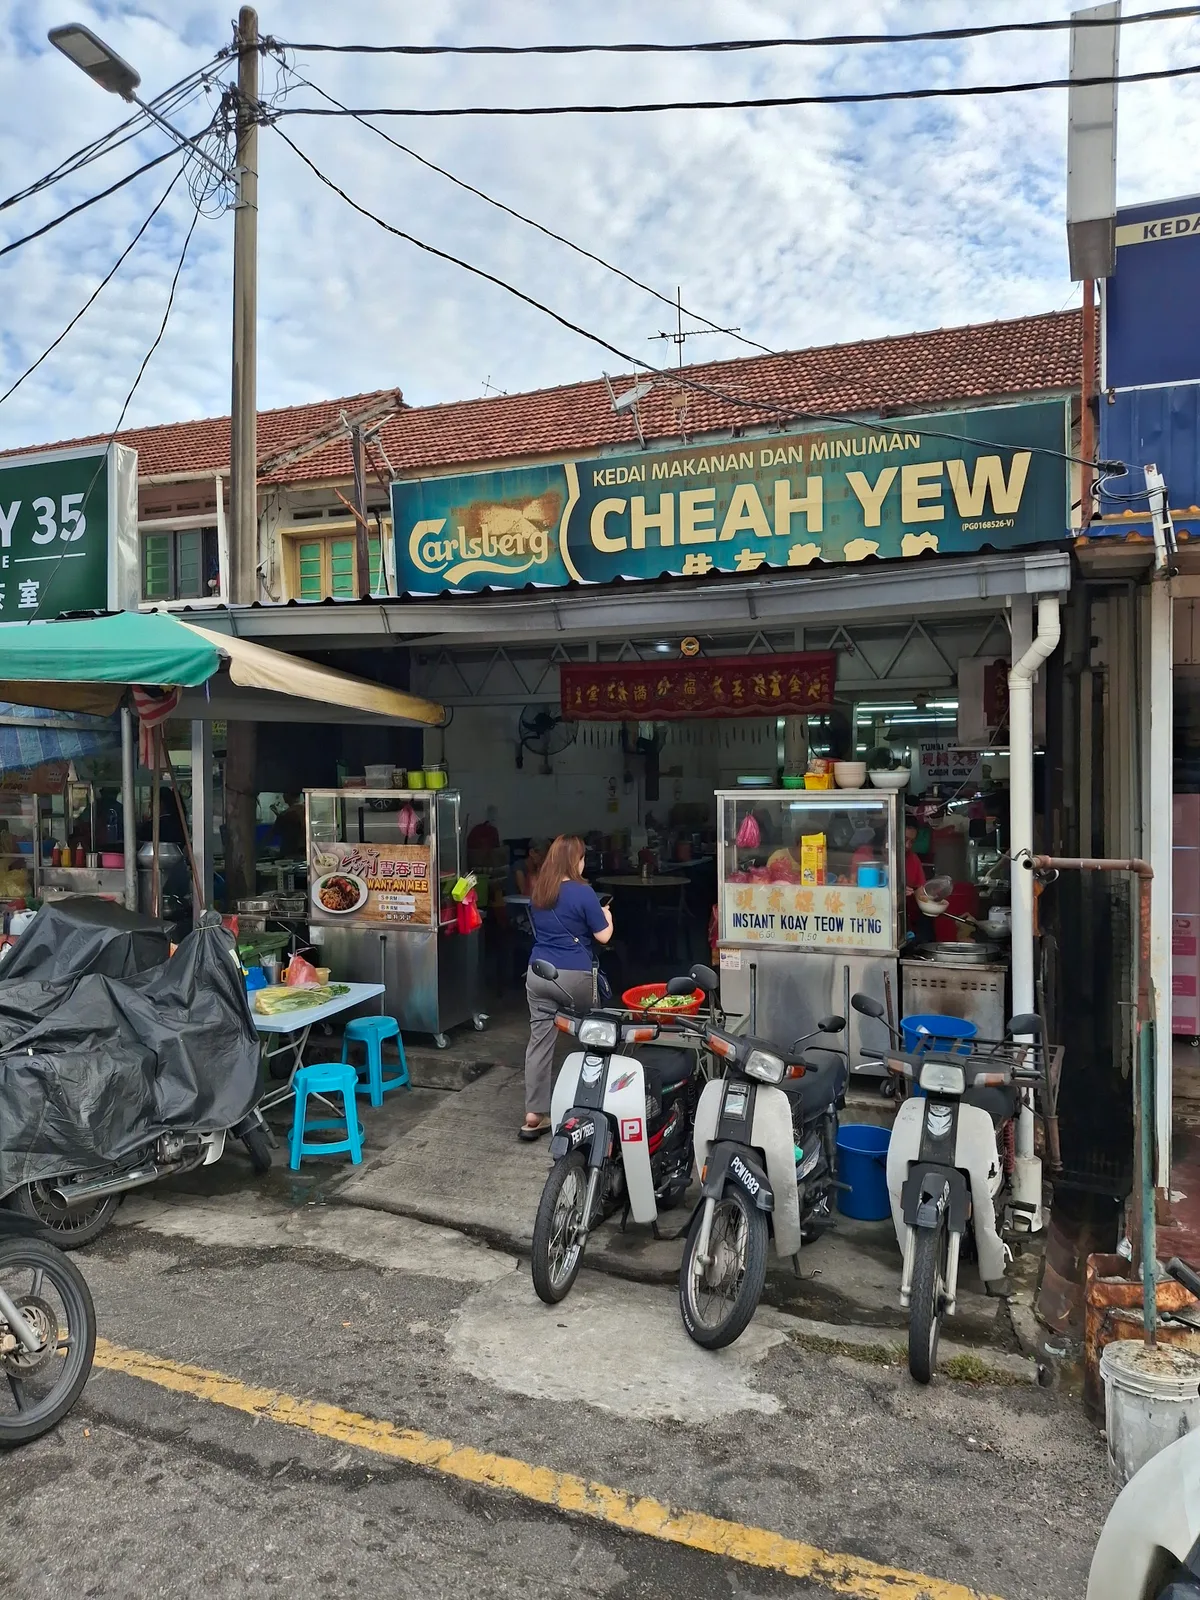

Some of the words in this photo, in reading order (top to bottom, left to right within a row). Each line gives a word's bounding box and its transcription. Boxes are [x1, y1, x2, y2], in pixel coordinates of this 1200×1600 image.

[593, 464, 646, 487] KEDAI
[651, 451, 754, 480] MAKANAN
[760, 445, 803, 467] DAN
[809, 433, 921, 462] MINUMAN
[0, 501, 22, 548] Y
[31, 493, 87, 545] 35
[590, 475, 824, 553] CHEAH
[845, 451, 1032, 527] YEW
[961, 518, 1015, 532] (PG0168526-V)
[409, 518, 550, 574] Carlsberg
[367, 878, 406, 892] WANTAN
[407, 880, 428, 892] MEE
[732, 912, 775, 930] INSTANT
[780, 915, 809, 931] KOAY
[814, 915, 845, 933] TEOW
[850, 917, 882, 934] TH'NG
[622, 1120, 640, 1140] P
